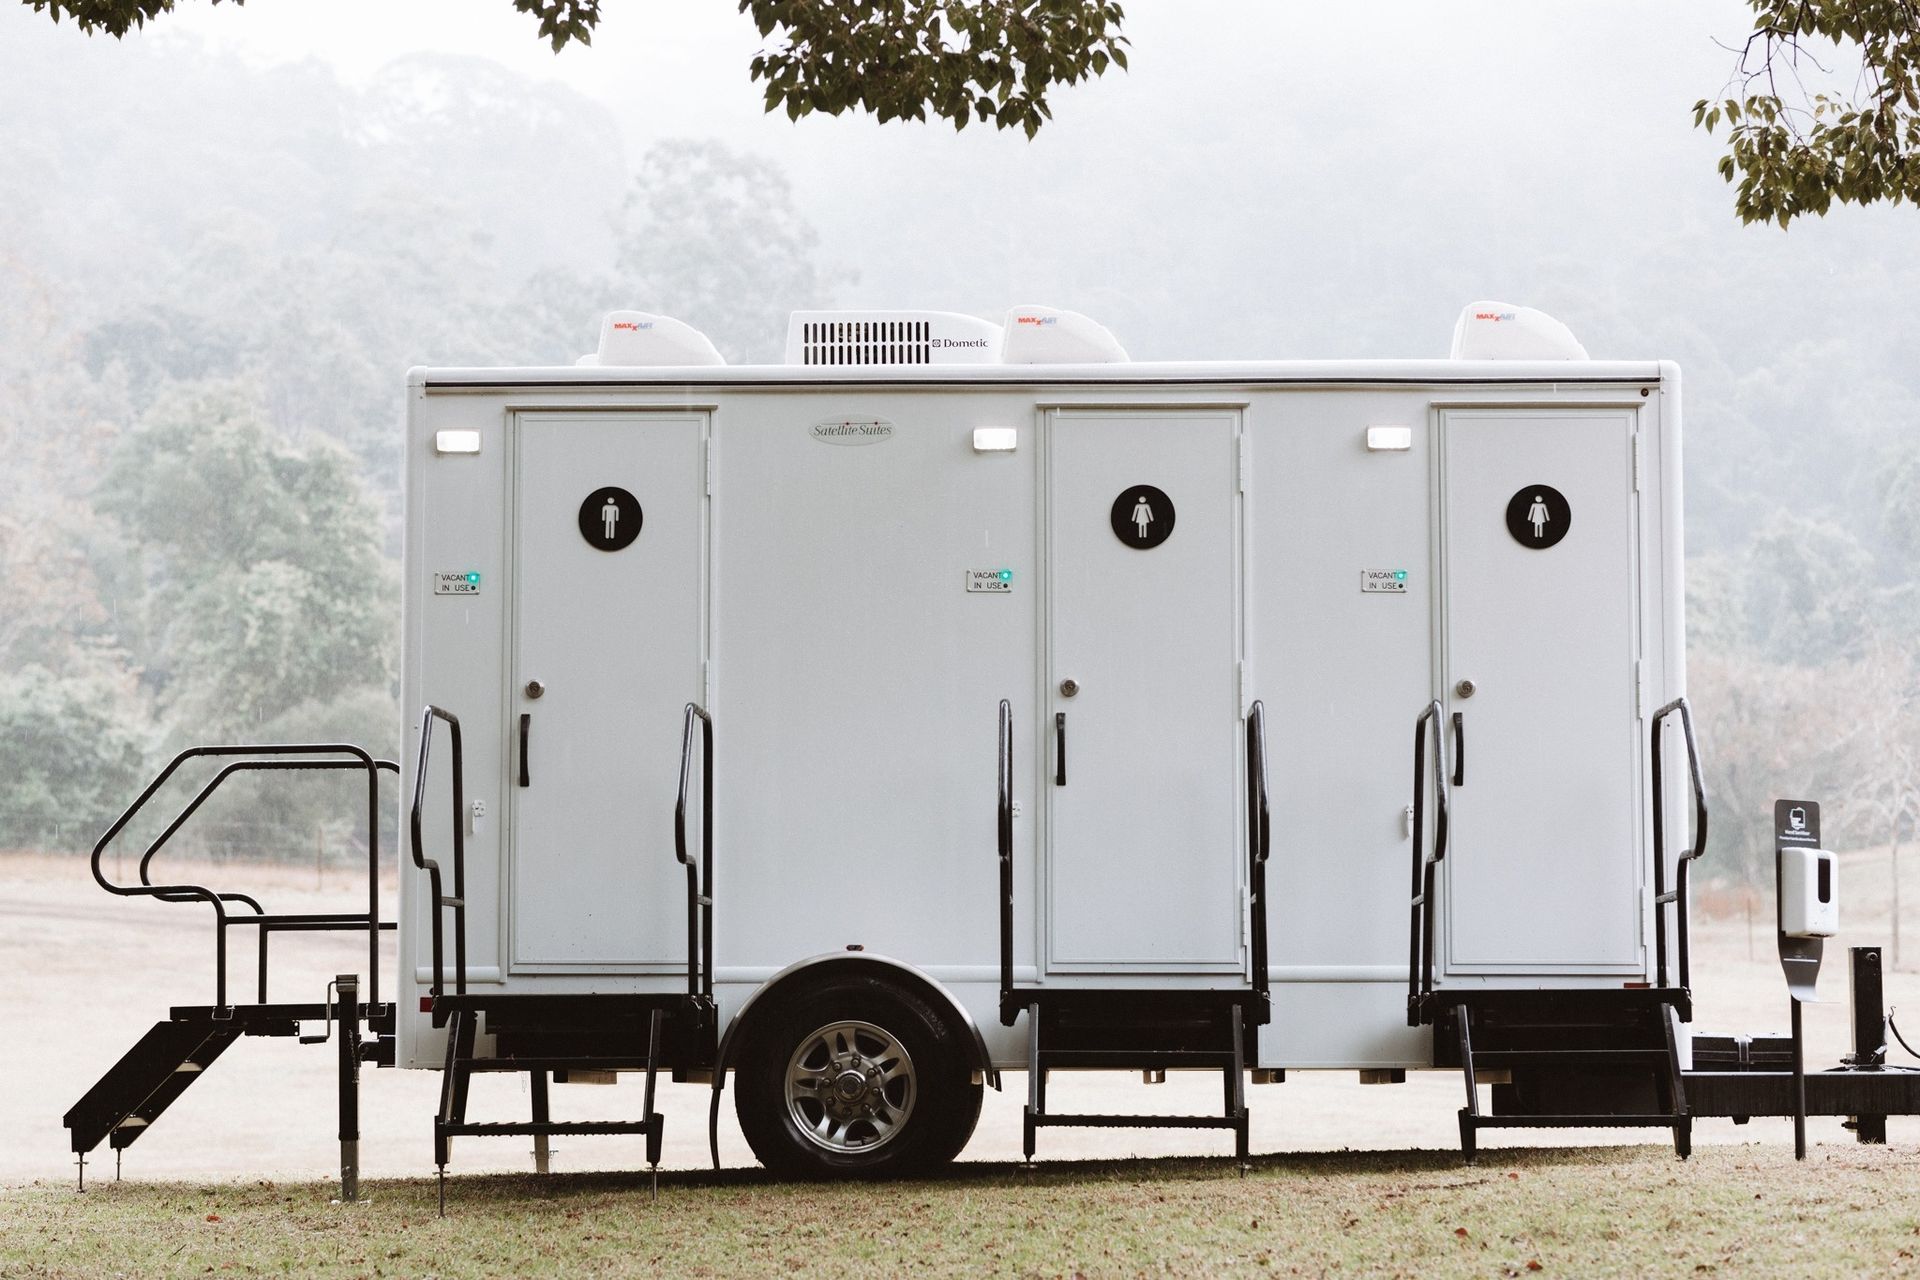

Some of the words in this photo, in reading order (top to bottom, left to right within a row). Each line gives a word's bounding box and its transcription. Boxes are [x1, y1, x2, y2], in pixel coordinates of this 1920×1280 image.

[944, 338, 988, 348] Dometic
[814, 422, 857, 436] Satellite
[859, 422, 892, 435] Suites
[973, 571, 1002, 579] VACANT
[1368, 571, 1397, 579] VACANT
[973, 581, 982, 589] IN
[986, 581, 1002, 590] USE
[1368, 581, 1377, 589] IN
[1381, 581, 1397, 590] USE
